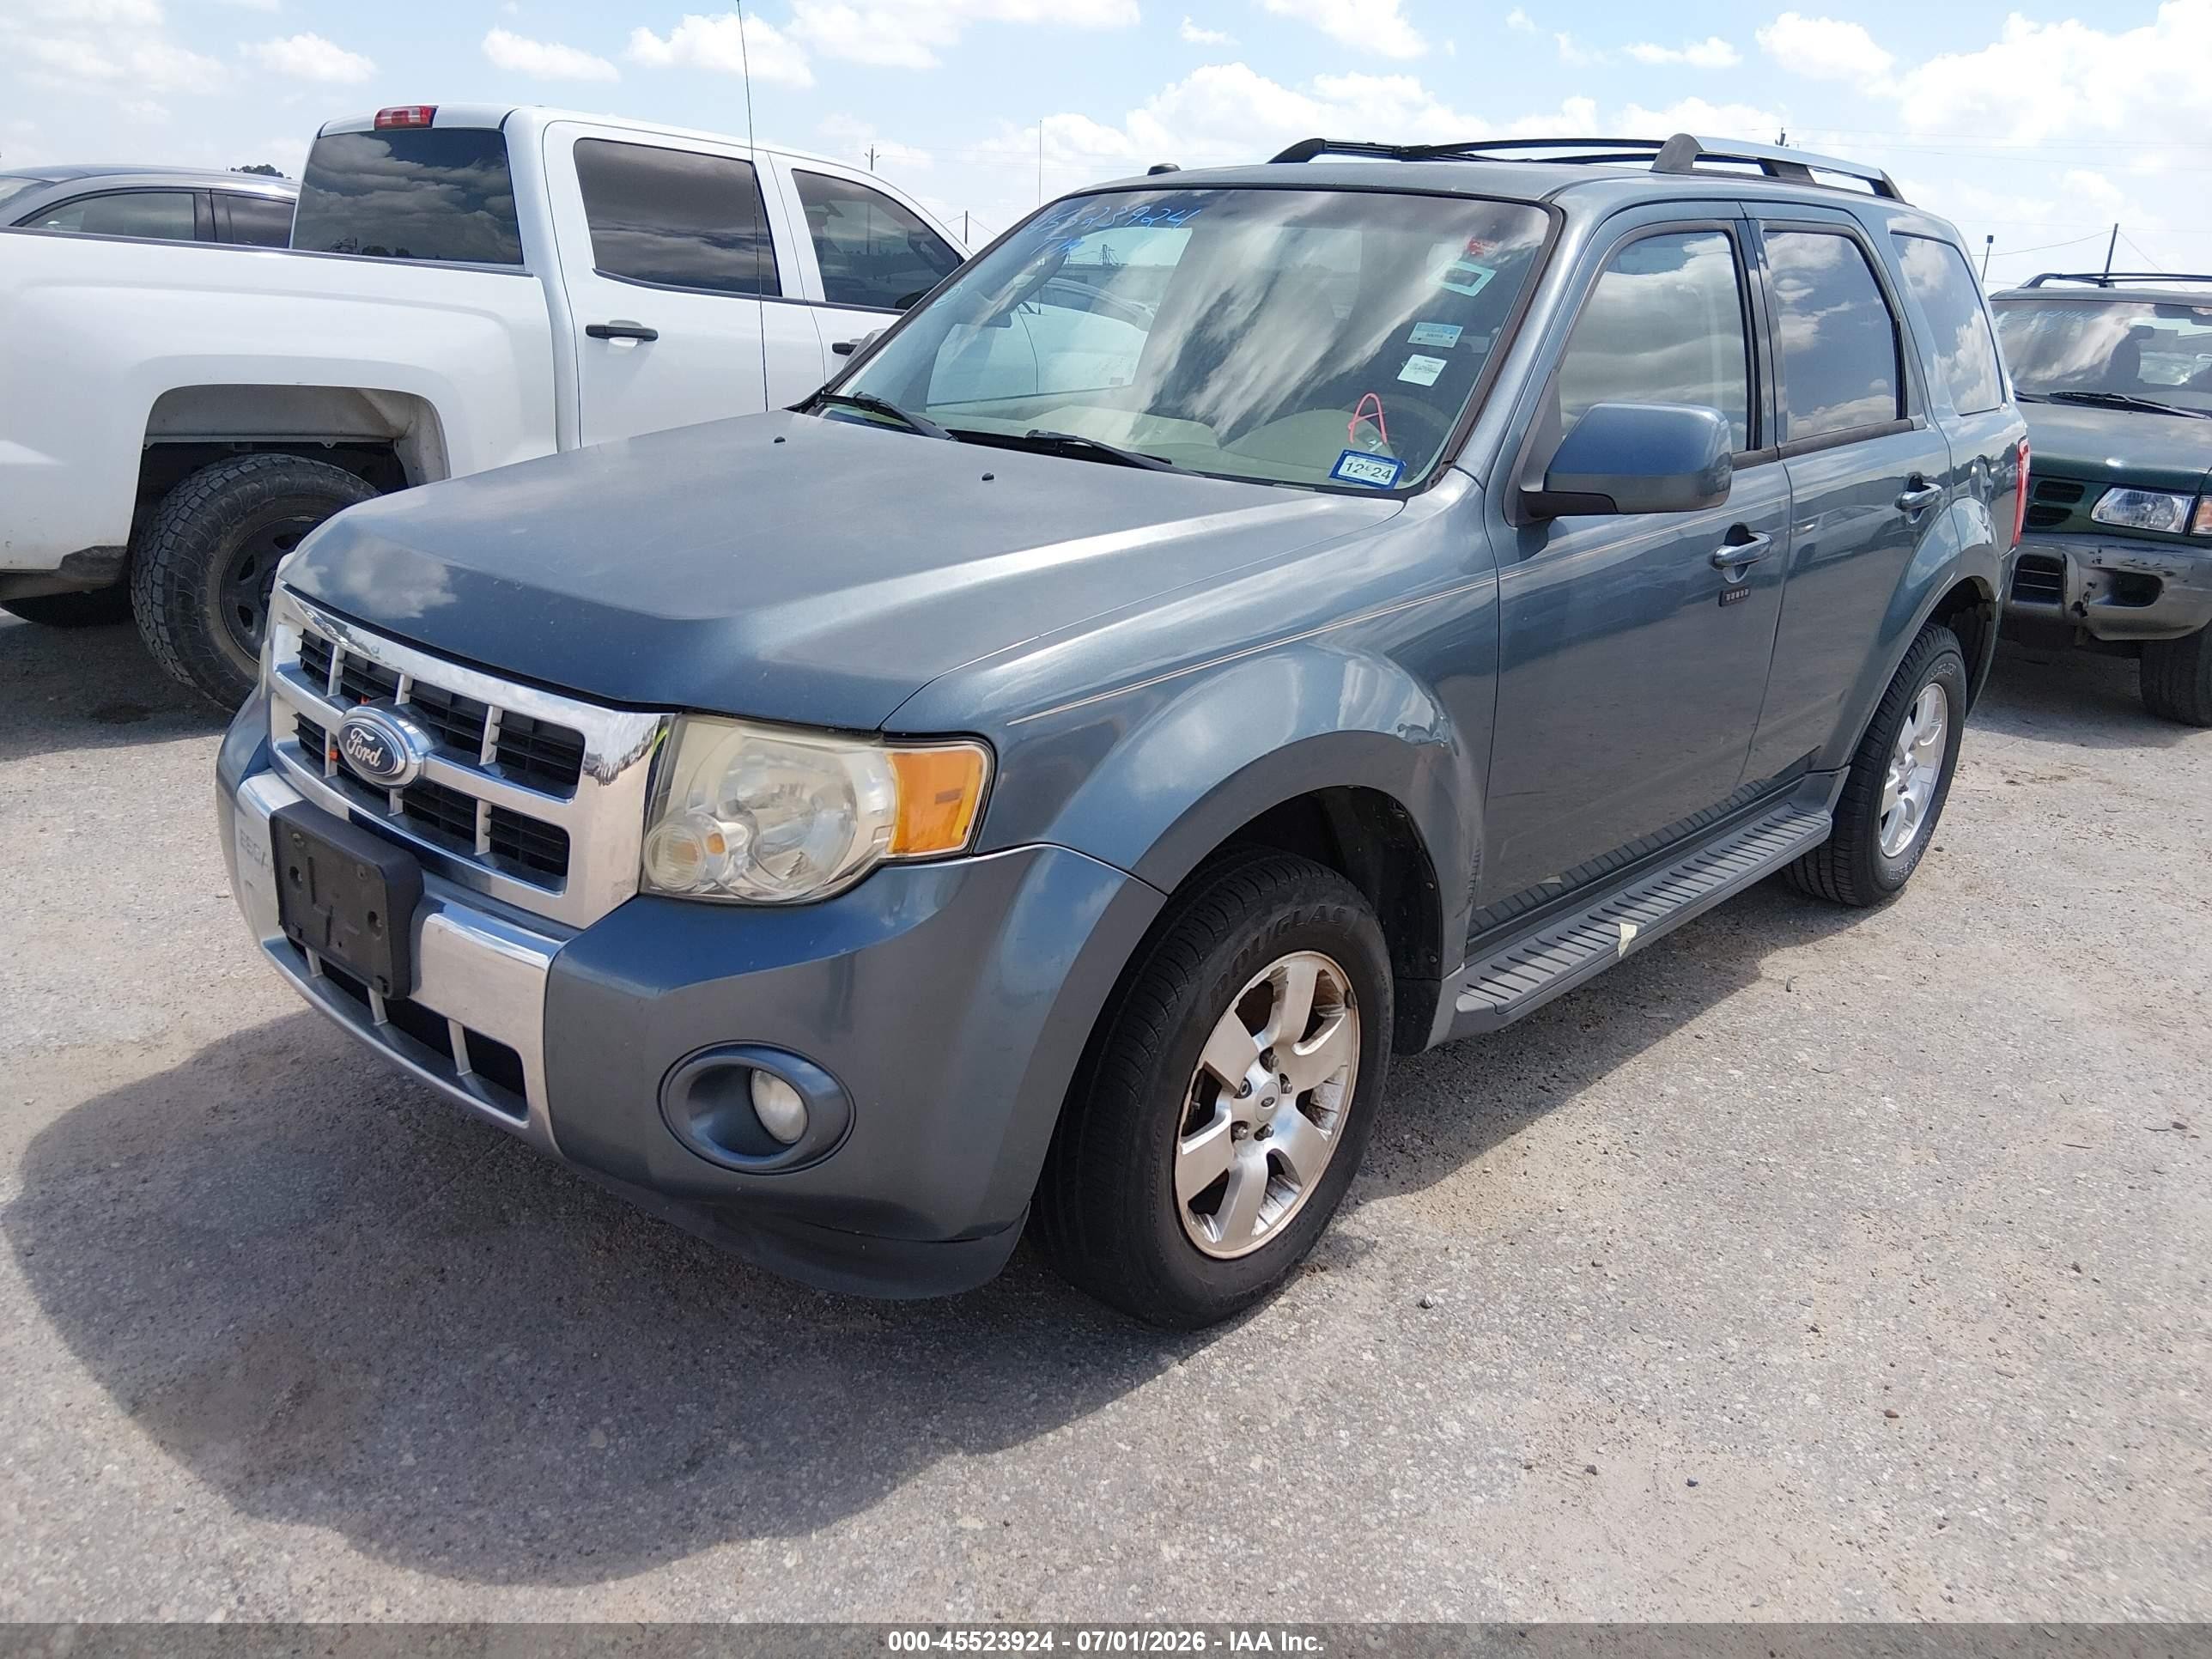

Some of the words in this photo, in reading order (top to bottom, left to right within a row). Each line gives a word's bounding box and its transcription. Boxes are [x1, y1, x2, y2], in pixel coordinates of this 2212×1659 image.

[1346, 462, 1364, 477] 12
[1370, 467, 1392, 480] 24
[346, 727, 384, 767] Ford
